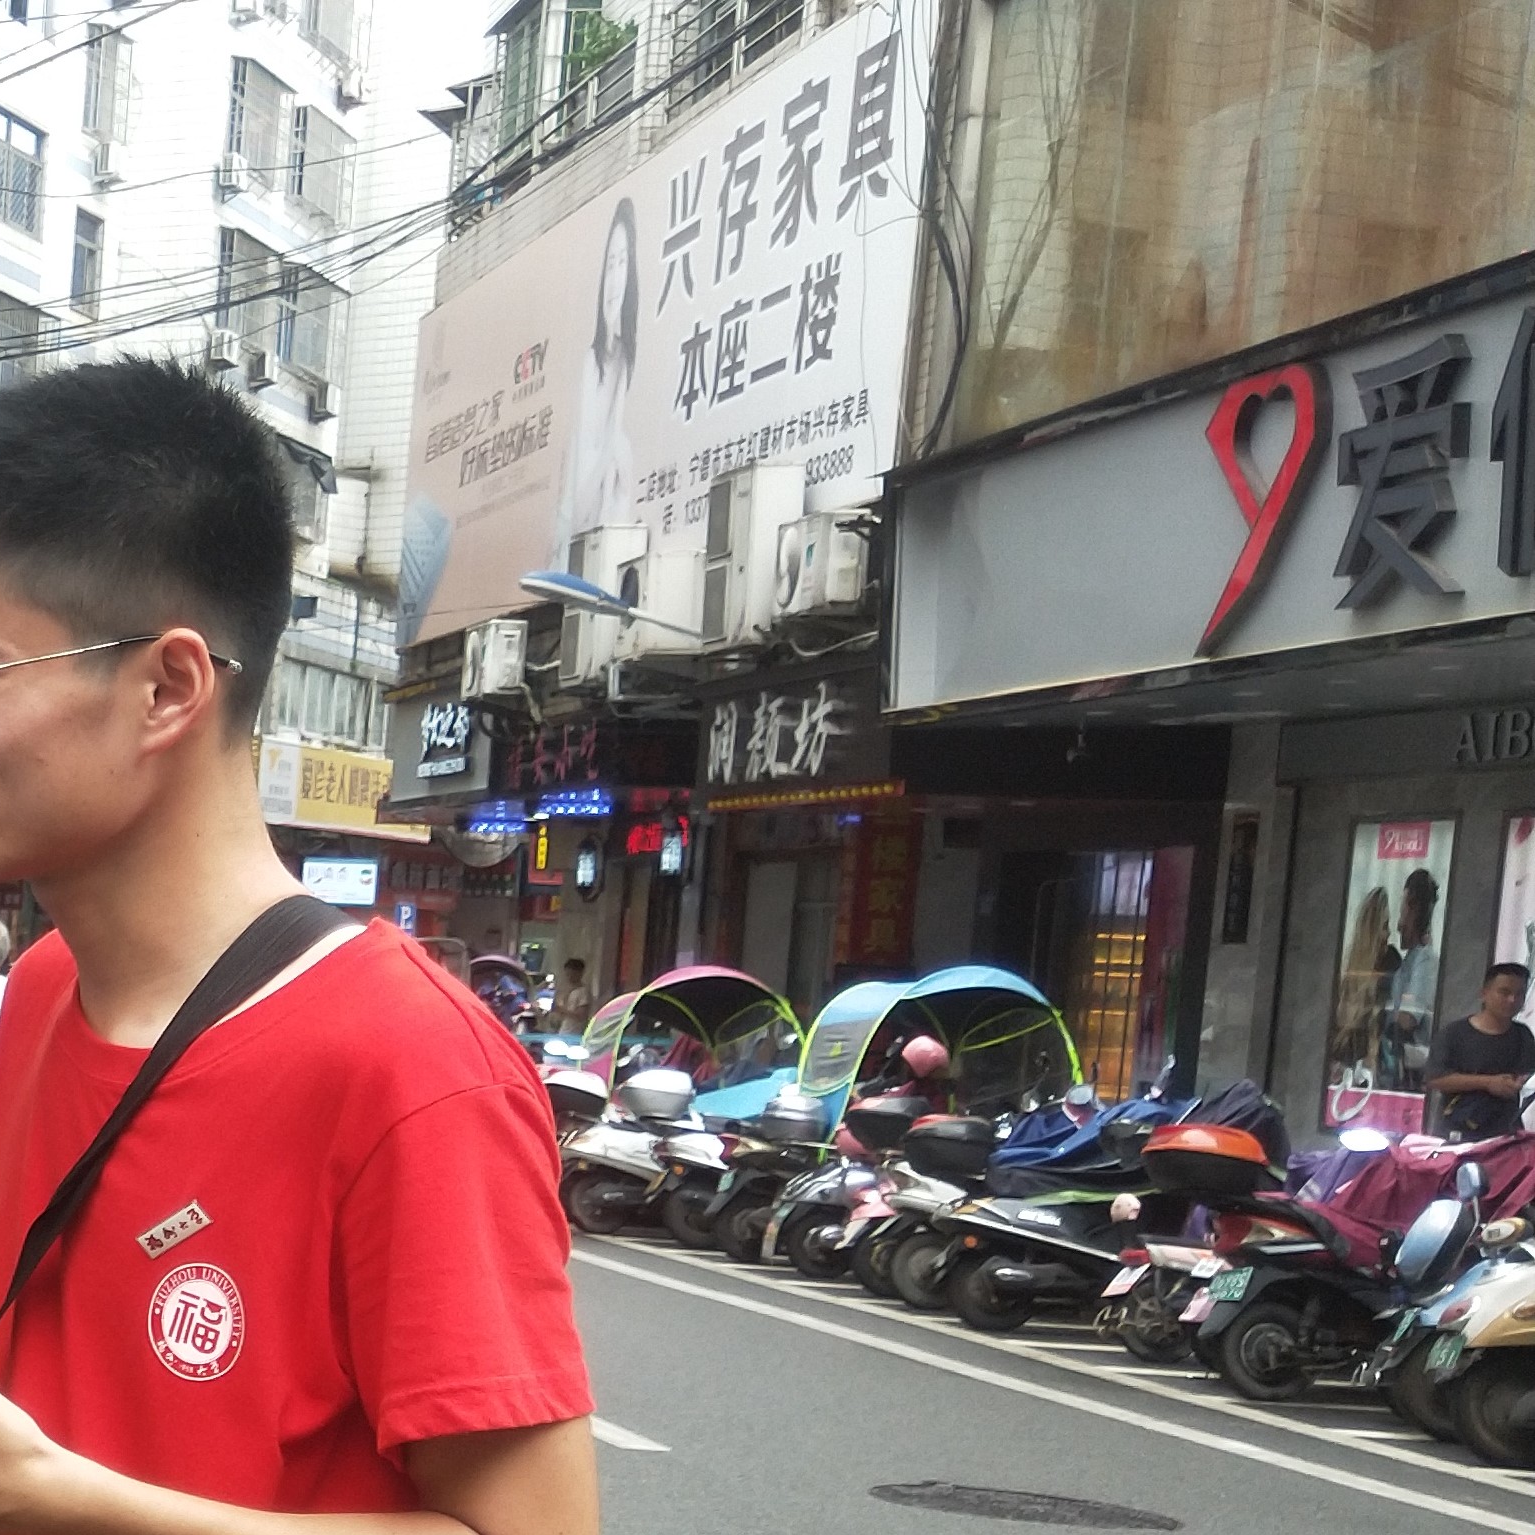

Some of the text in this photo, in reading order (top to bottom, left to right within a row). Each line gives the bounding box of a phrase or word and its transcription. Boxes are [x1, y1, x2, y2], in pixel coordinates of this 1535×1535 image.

[656, 29, 900, 318] 兴存家具
[673, 252, 841, 422] 本座二楼
[1453, 709, 1535, 762] AIB
[155, 1267, 197, 1307] FUZHOU
